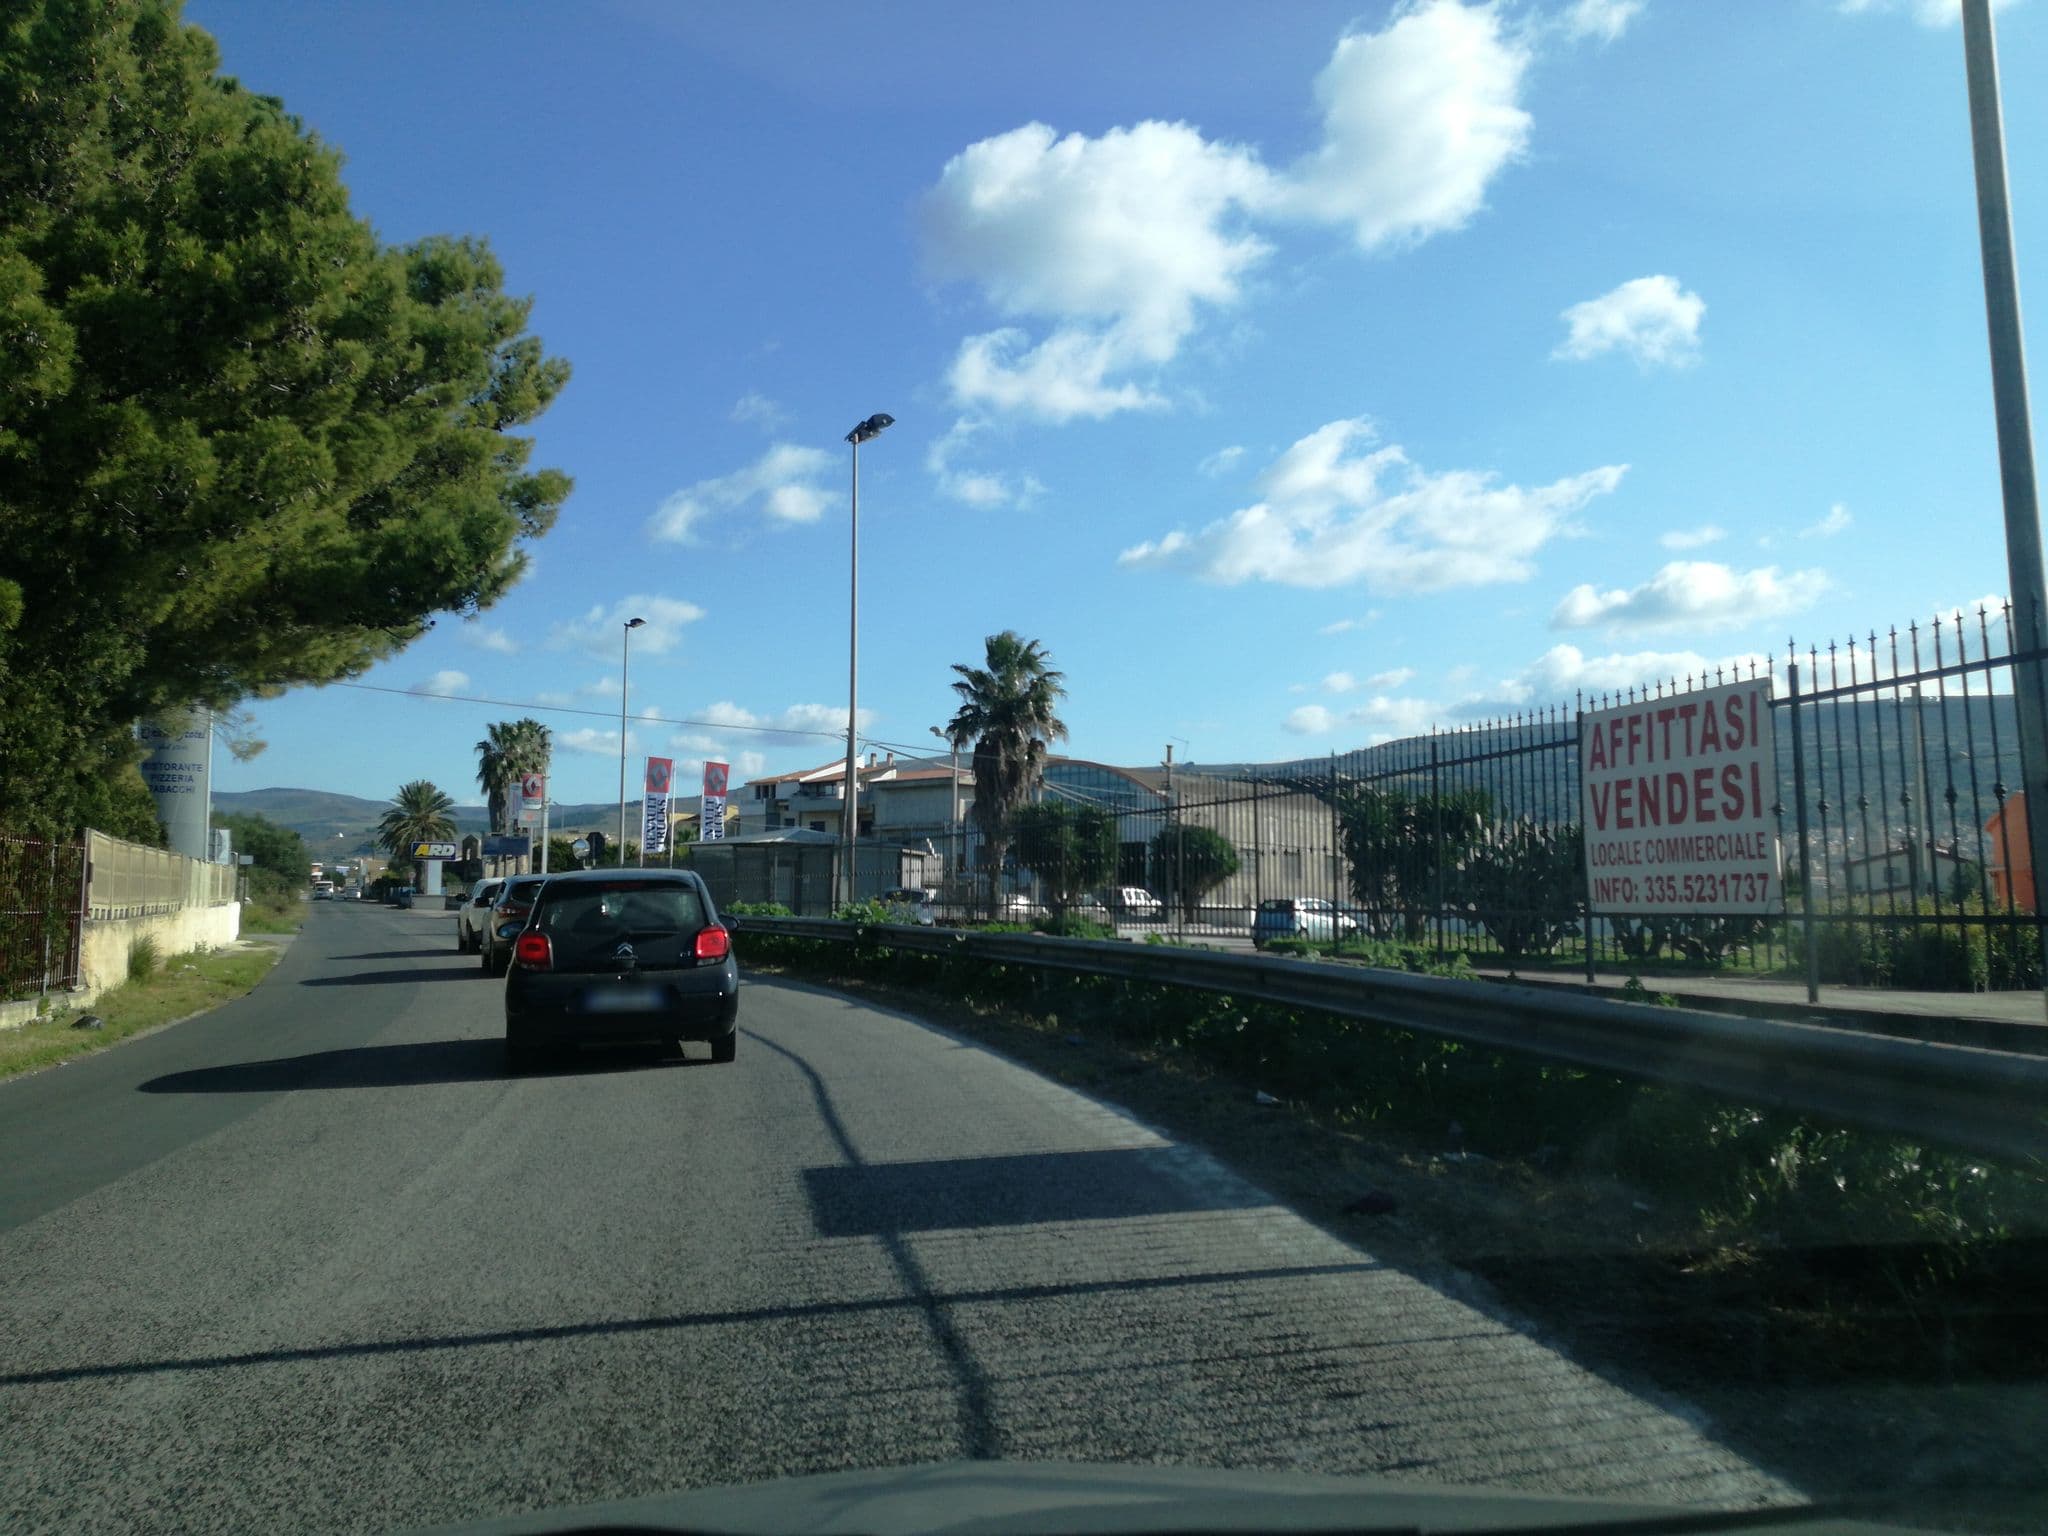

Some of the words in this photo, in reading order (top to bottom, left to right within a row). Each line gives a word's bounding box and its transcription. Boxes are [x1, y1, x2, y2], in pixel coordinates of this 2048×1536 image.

[1589, 692, 1758, 771] AFFITTASI
[1590, 762, 1762, 831] VENDESI
[646, 795, 657, 850] RENAULT
[656, 799, 667, 845] TRUCKS
[414, 844, 455, 856] ARD
[1591, 840, 1642, 867] LOCALE
[1647, 832, 1767, 865] COMMERCIALE
[1594, 878, 1638, 904] INFO:
[1644, 873, 1769, 903] 335.5231737
